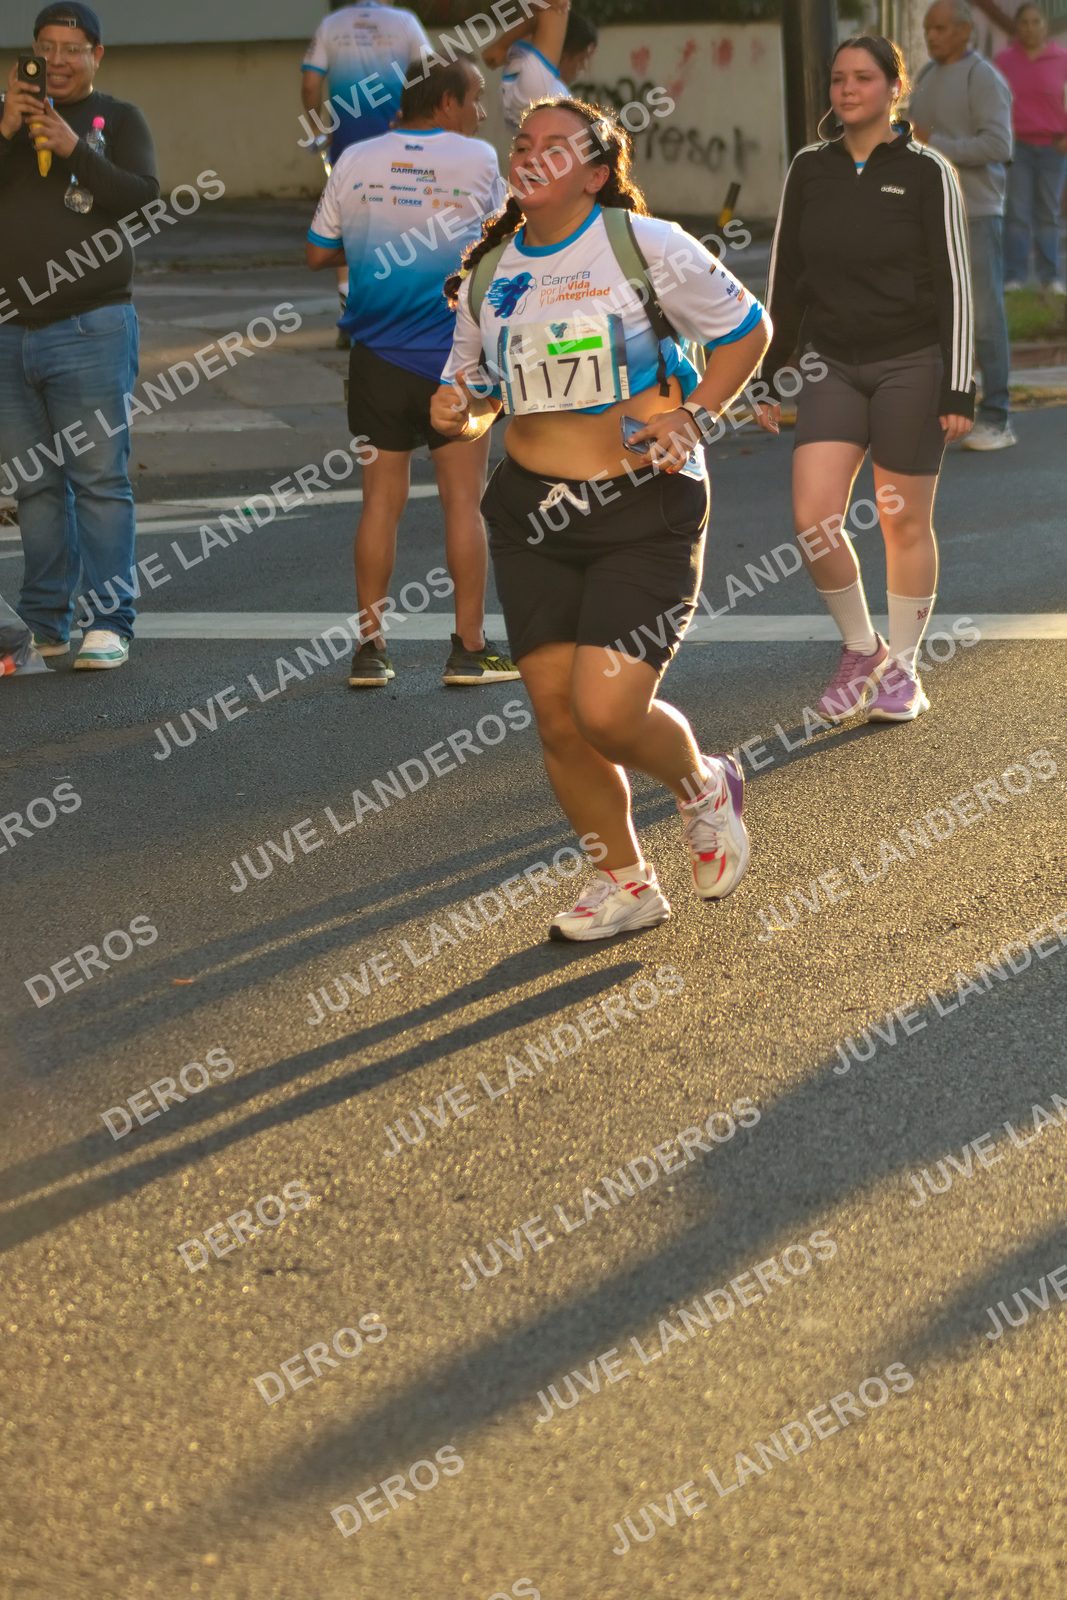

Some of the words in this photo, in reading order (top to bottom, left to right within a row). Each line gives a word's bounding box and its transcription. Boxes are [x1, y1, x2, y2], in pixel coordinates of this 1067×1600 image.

[881, 186, 905, 195] adidas
[541, 270, 590, 286] Carrera
[567, 280, 590, 291] Vida
[514, 355, 601, 401] 1171
